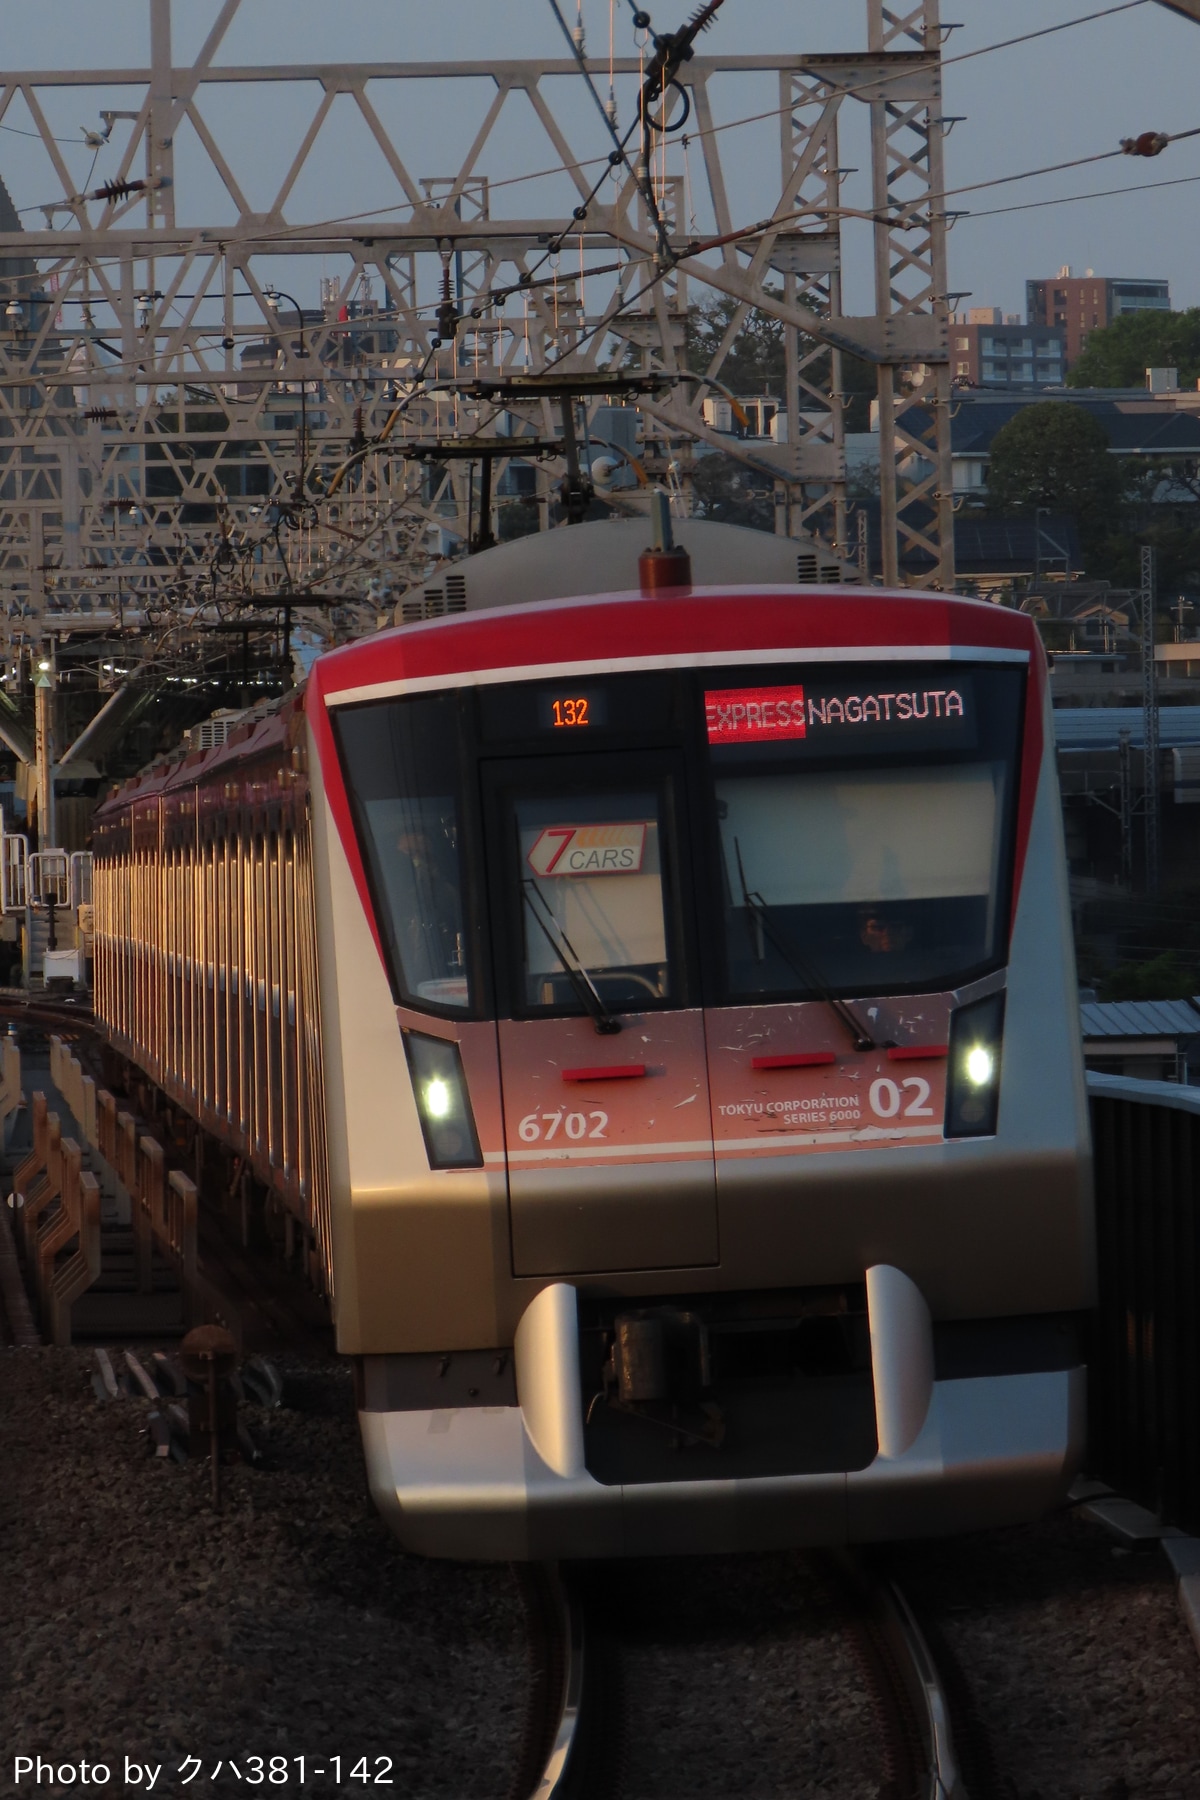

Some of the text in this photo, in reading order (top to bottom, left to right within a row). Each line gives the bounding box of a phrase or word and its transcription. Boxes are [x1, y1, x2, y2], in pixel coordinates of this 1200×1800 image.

[552, 699, 589, 726] 132
[705, 690, 964, 731] EXPRESS NAGATSUTA
[545, 829, 577, 873] 7
[569, 848, 635, 870] CARS
[718, 1097, 860, 1116] TOKYU CORPORATION
[868, 1077, 934, 1118] 02
[518, 1111, 609, 1142] 6702
[783, 1109, 861, 1125] SERIES 6000
